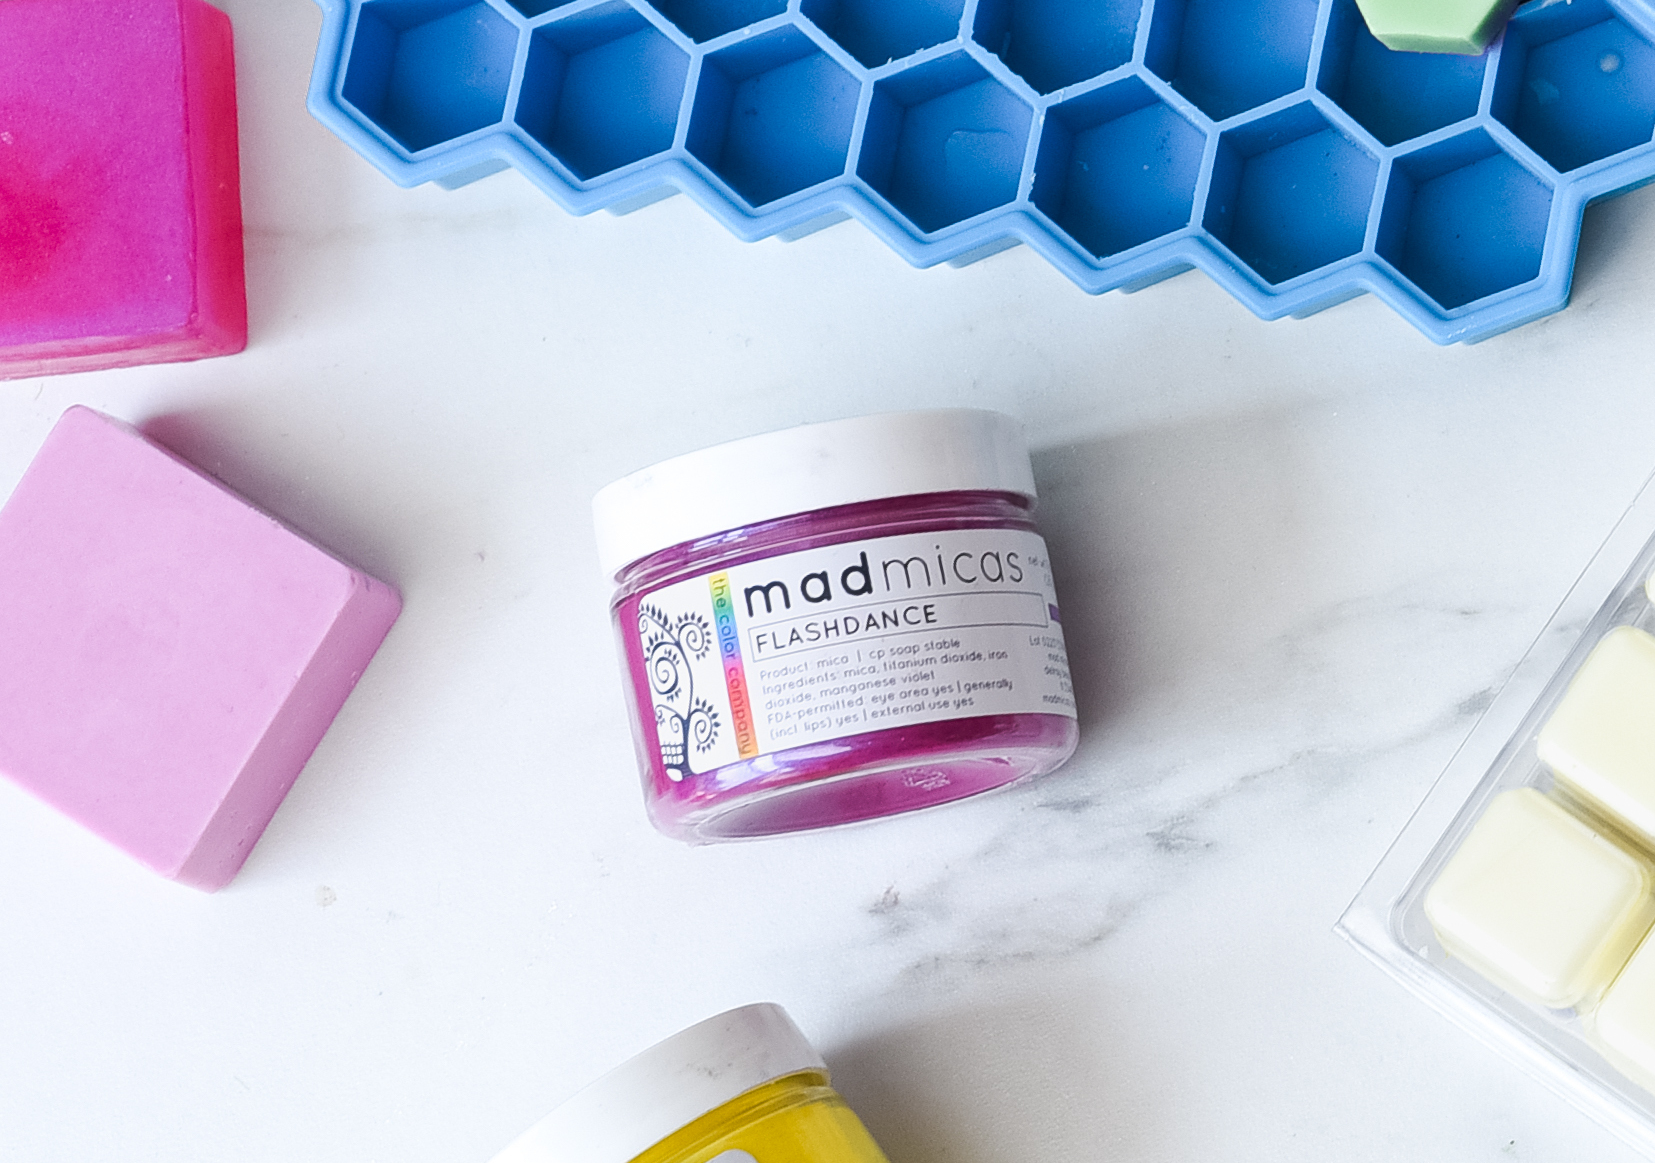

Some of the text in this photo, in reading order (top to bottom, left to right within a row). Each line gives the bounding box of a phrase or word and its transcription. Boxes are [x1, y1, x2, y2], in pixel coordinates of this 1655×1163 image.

[713, 578, 727, 608] the
[744, 544, 1024, 617] madmicas
[718, 614, 736, 659] color
[756, 604, 938, 654] FLASHDANCE
[817, 655, 849, 669] mica
[869, 649, 886, 660] cp
[890, 643, 920, 655] soap
[924, 637, 960, 651] stable
[883, 654, 937, 673] titanium
[987, 650, 1008, 661] iron
[820, 677, 896, 696] manganese
[901, 669, 935, 684] violet
[871, 692, 895, 705] eye
[899, 686, 930, 700] area
[932, 683, 954, 697] yes
[963, 678, 1013, 694] generally
[835, 713, 859, 728] yes
[871, 701, 925, 718] external
[928, 698, 950, 710] use
[953, 696, 975, 710] yes
